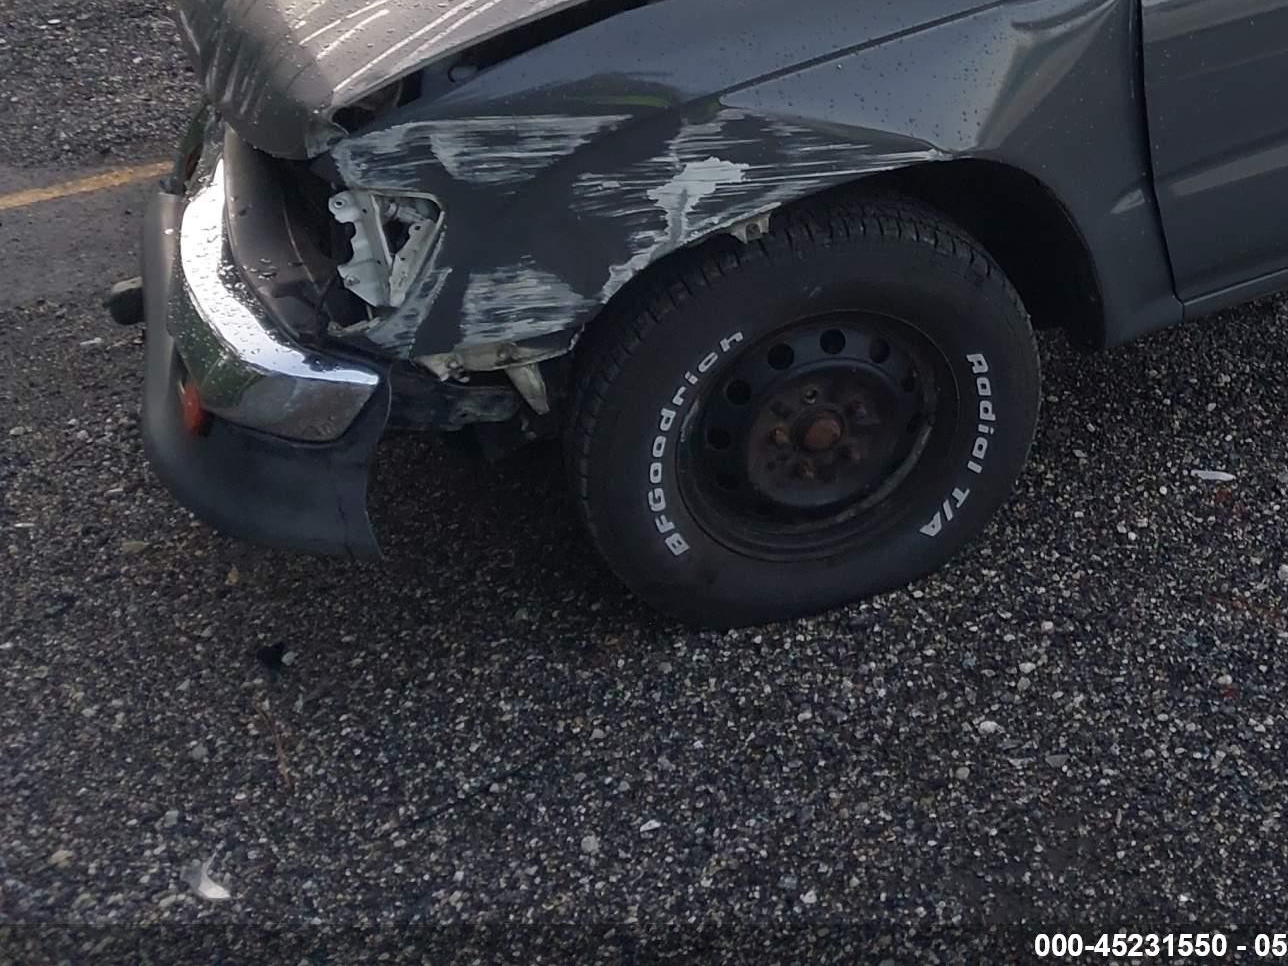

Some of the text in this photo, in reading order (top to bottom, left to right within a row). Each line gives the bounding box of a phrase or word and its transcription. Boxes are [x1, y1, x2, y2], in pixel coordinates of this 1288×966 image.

[648, 332, 744, 557] BFGoodrich
[919, 353, 997, 537] Radial T/A
